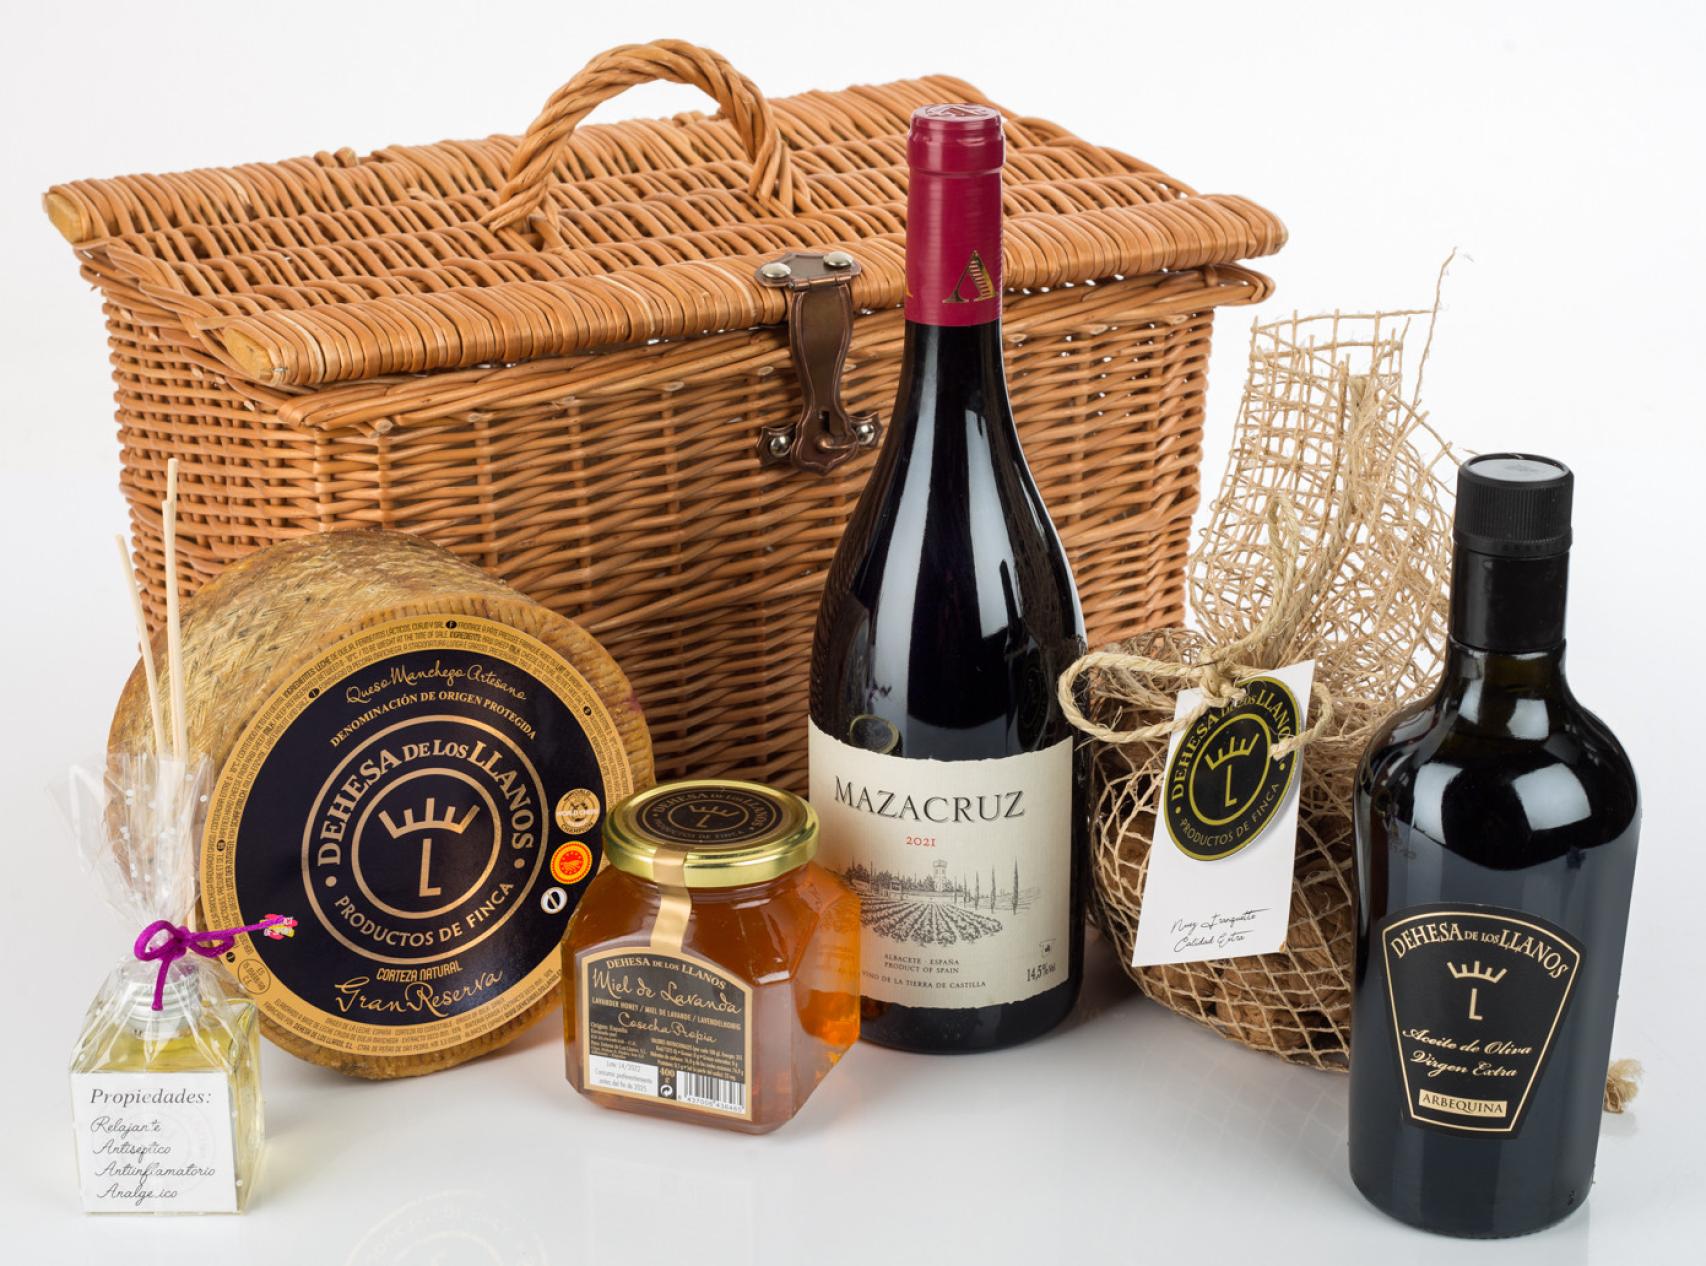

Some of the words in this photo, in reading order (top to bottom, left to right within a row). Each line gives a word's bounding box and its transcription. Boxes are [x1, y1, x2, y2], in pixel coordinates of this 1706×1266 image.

[329, 691, 418, 748] DENOMINACIÓN
[420, 691, 436, 701] DE
[438, 690, 487, 706] ORIGEN
[483, 698, 538, 740] PROTEGIDA
[1171, 712, 1221, 801] DEHESA
[1256, 688, 1292, 741] LLANO
[317, 746, 403, 867] DEHESA
[402, 742, 430, 760] DE
[432, 739, 469, 758] LOS
[466, 740, 534, 850] LLANOS
[834, 775, 1026, 824] MAZACRUZ
[1179, 816, 1234, 848] PRODUCTOS
[1235, 822, 1249, 839] DE
[1251, 782, 1280, 823] FINCA
[906, 835, 937, 848] 2021
[335, 895, 434, 947] PRODUCTOS
[438, 924, 463, 944] DE
[465, 881, 514, 931] FINCA
[884, 953, 922, 966] ALBACETE
[929, 957, 960, 966] ESPAÑA
[1390, 921, 1464, 959] DEHESA
[1464, 931, 1479, 942] DE
[1481, 932, 1500, 944] LOS
[1499, 929, 1568, 979] LLANOS
[376, 967, 418, 983] CORTEZA
[419, 960, 464, 981] NATURAL
[606, 957, 650, 969] DEHESA
[681, 964, 728, 990] LLANOS
[881, 975, 891, 983] DE
[893, 977, 904, 985] LA
[906, 978, 933, 989] TIERRA
[935, 981, 946, 989] DE
[949, 980, 986, 989] CASTILLA
[884, 962, 920, 973] PRODUCT
[922, 966, 933, 974] OF
[936, 966, 960, 974] SPAIN
[334, 976, 407, 1013] Gran
[405, 969, 504, 1018] Reserva
[592, 968, 633, 999] Miel
[660, 981, 742, 1014] Lavanda
[1402, 1027, 1457, 1050] Aceite
[1459, 1039, 1480, 1054] de
[1484, 1041, 1533, 1055] Oliva
[1410, 1049, 1468, 1077] Virgen
[1472, 1060, 1518, 1077] Extra
[90, 1088, 211, 1108] Propiedades:
[1421, 1092, 1503, 1114] ARBEQUINA
[96, 1182, 179, 1207] Analgeico
